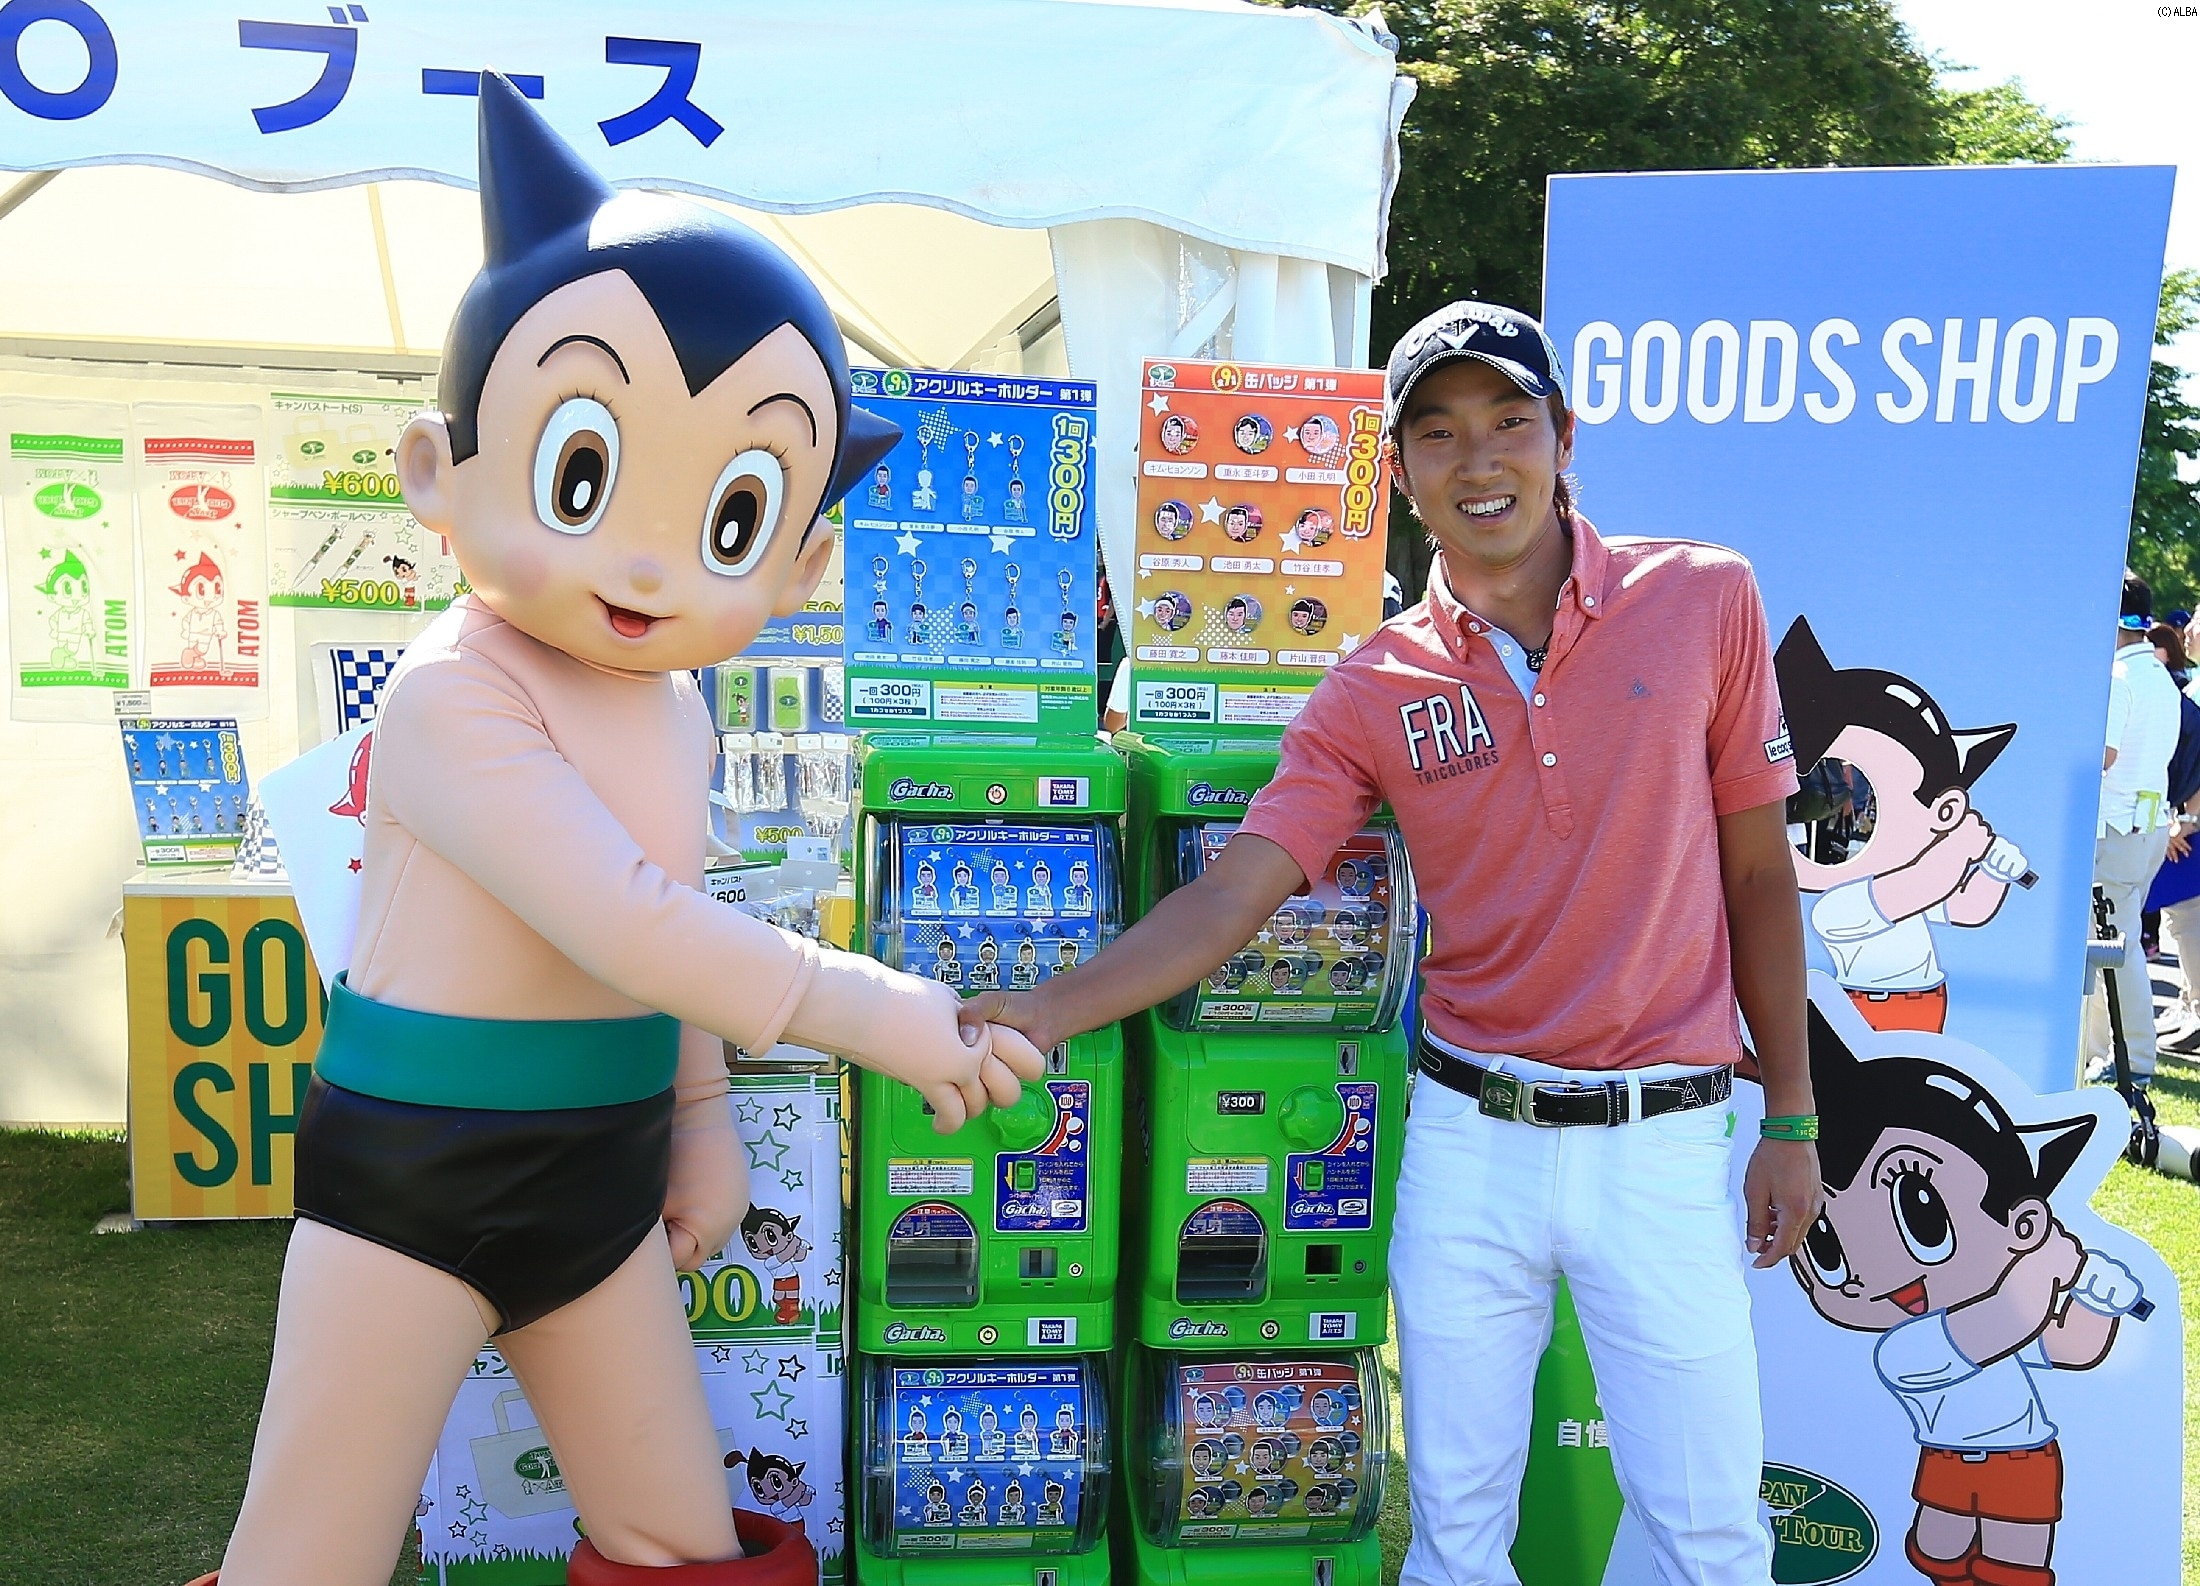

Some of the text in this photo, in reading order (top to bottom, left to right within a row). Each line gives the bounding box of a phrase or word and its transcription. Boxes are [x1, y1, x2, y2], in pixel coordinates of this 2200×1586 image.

[238, 4, 724, 148] ブース
[1244, 371, 1298, 391] 缶バッジ
[1303, 378, 1337, 392] 第1弾
[1572, 317, 2120, 424] GOODS SHOP
[914, 378, 1053, 400] アクリルキーホルダー
[1060, 387, 1093, 403] 第1弾
[323, 469, 400, 498] ¥600
[1152, 556, 1190, 568] 谷原 秀人
[1223, 560, 1262, 571] 池田 勇太
[1293, 563, 1311, 573] 竹谷
[321, 577, 400, 605] ¥500
[104, 600, 128, 658] ATOM
[237, 600, 259, 657] ATOM
[1400, 684, 1494, 772] FRA
[1415, 750, 1499, 786] TRICOLORES
[955, 829, 1060, 842] アクリルキーホルダー
[1221, 1095, 1255, 1109] ¥300
[946, 1373, 1048, 1384] アクリルキーホルダー
[1256, 1367, 1294, 1379] 缶バッジ
[1776, 1515, 1865, 1553] TOUR
